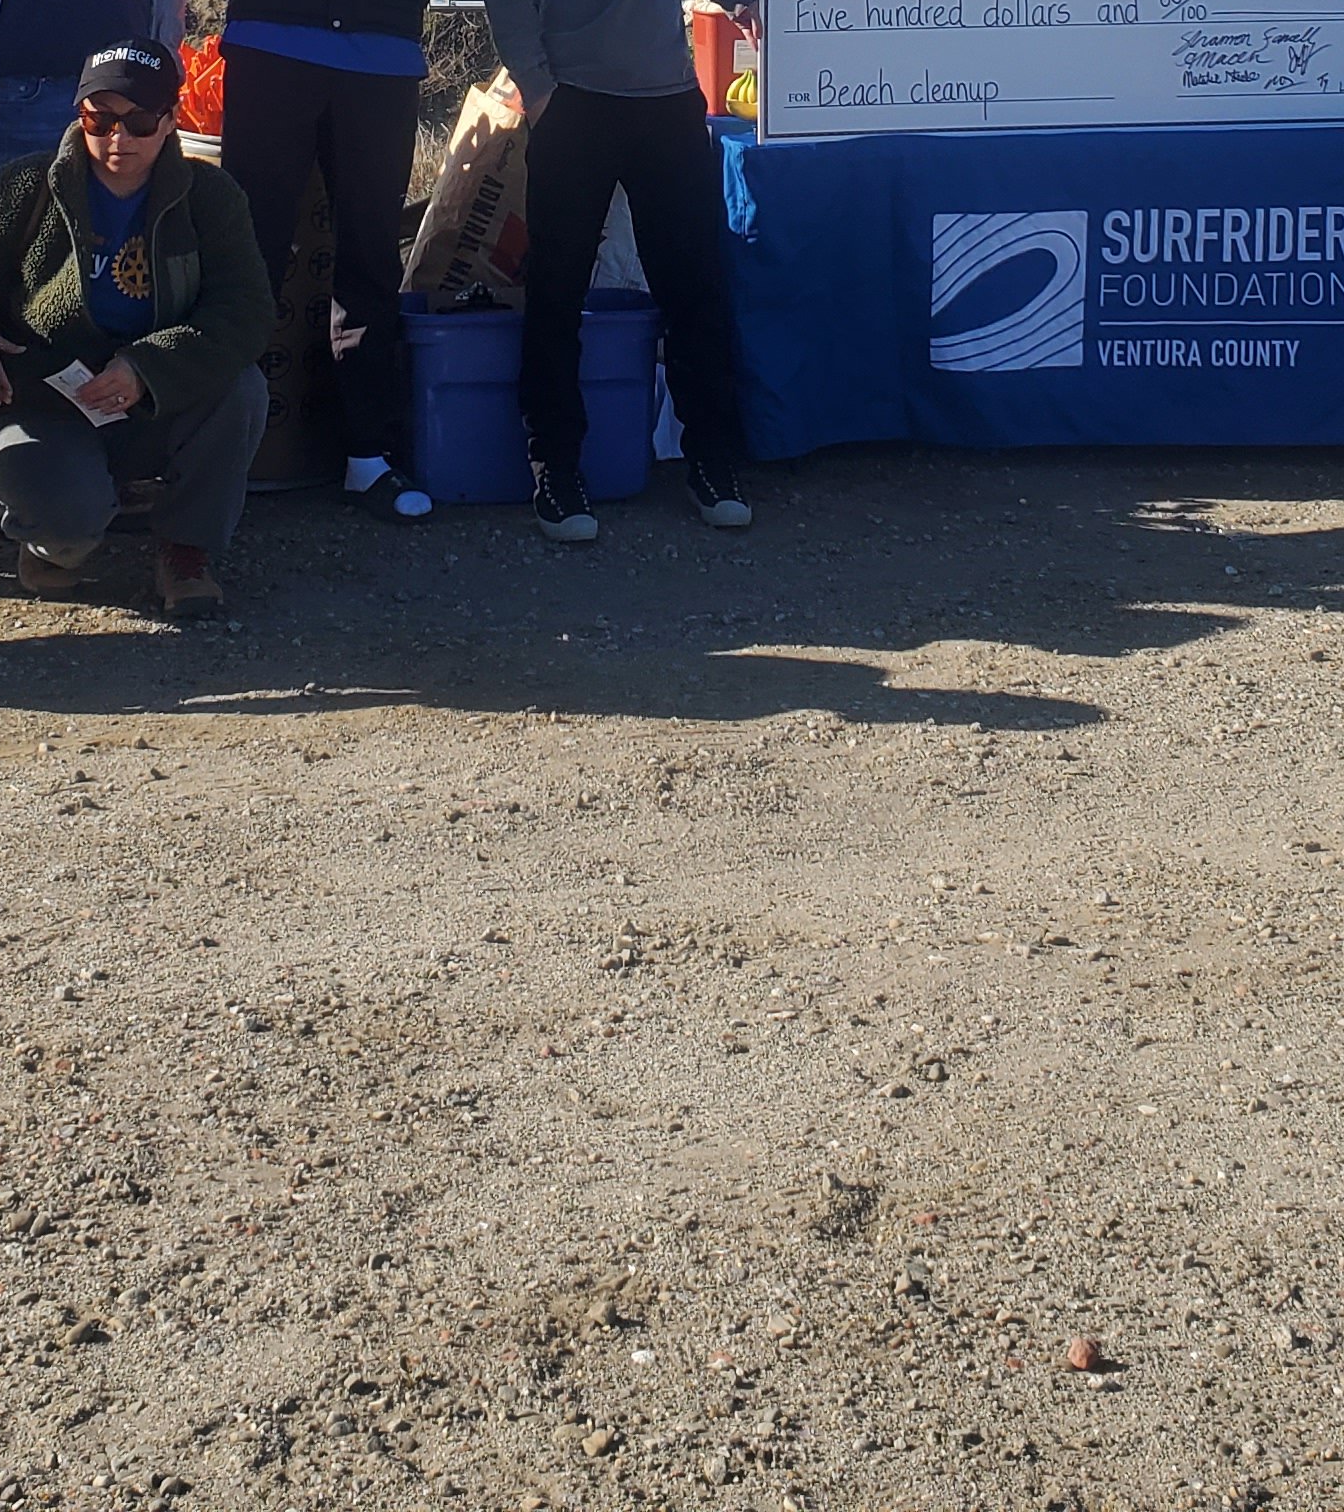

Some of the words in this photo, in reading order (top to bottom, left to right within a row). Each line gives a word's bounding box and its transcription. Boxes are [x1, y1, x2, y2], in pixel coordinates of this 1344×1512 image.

[788, 92, 811, 103] FOR
[818, 67, 895, 107] Beach
[910, 68, 999, 121] cleanup
[457, 173, 504, 252] ADMIRAL
[1097, 340, 1202, 367] VENTURA
[1211, 339, 1300, 367] COUNTY
